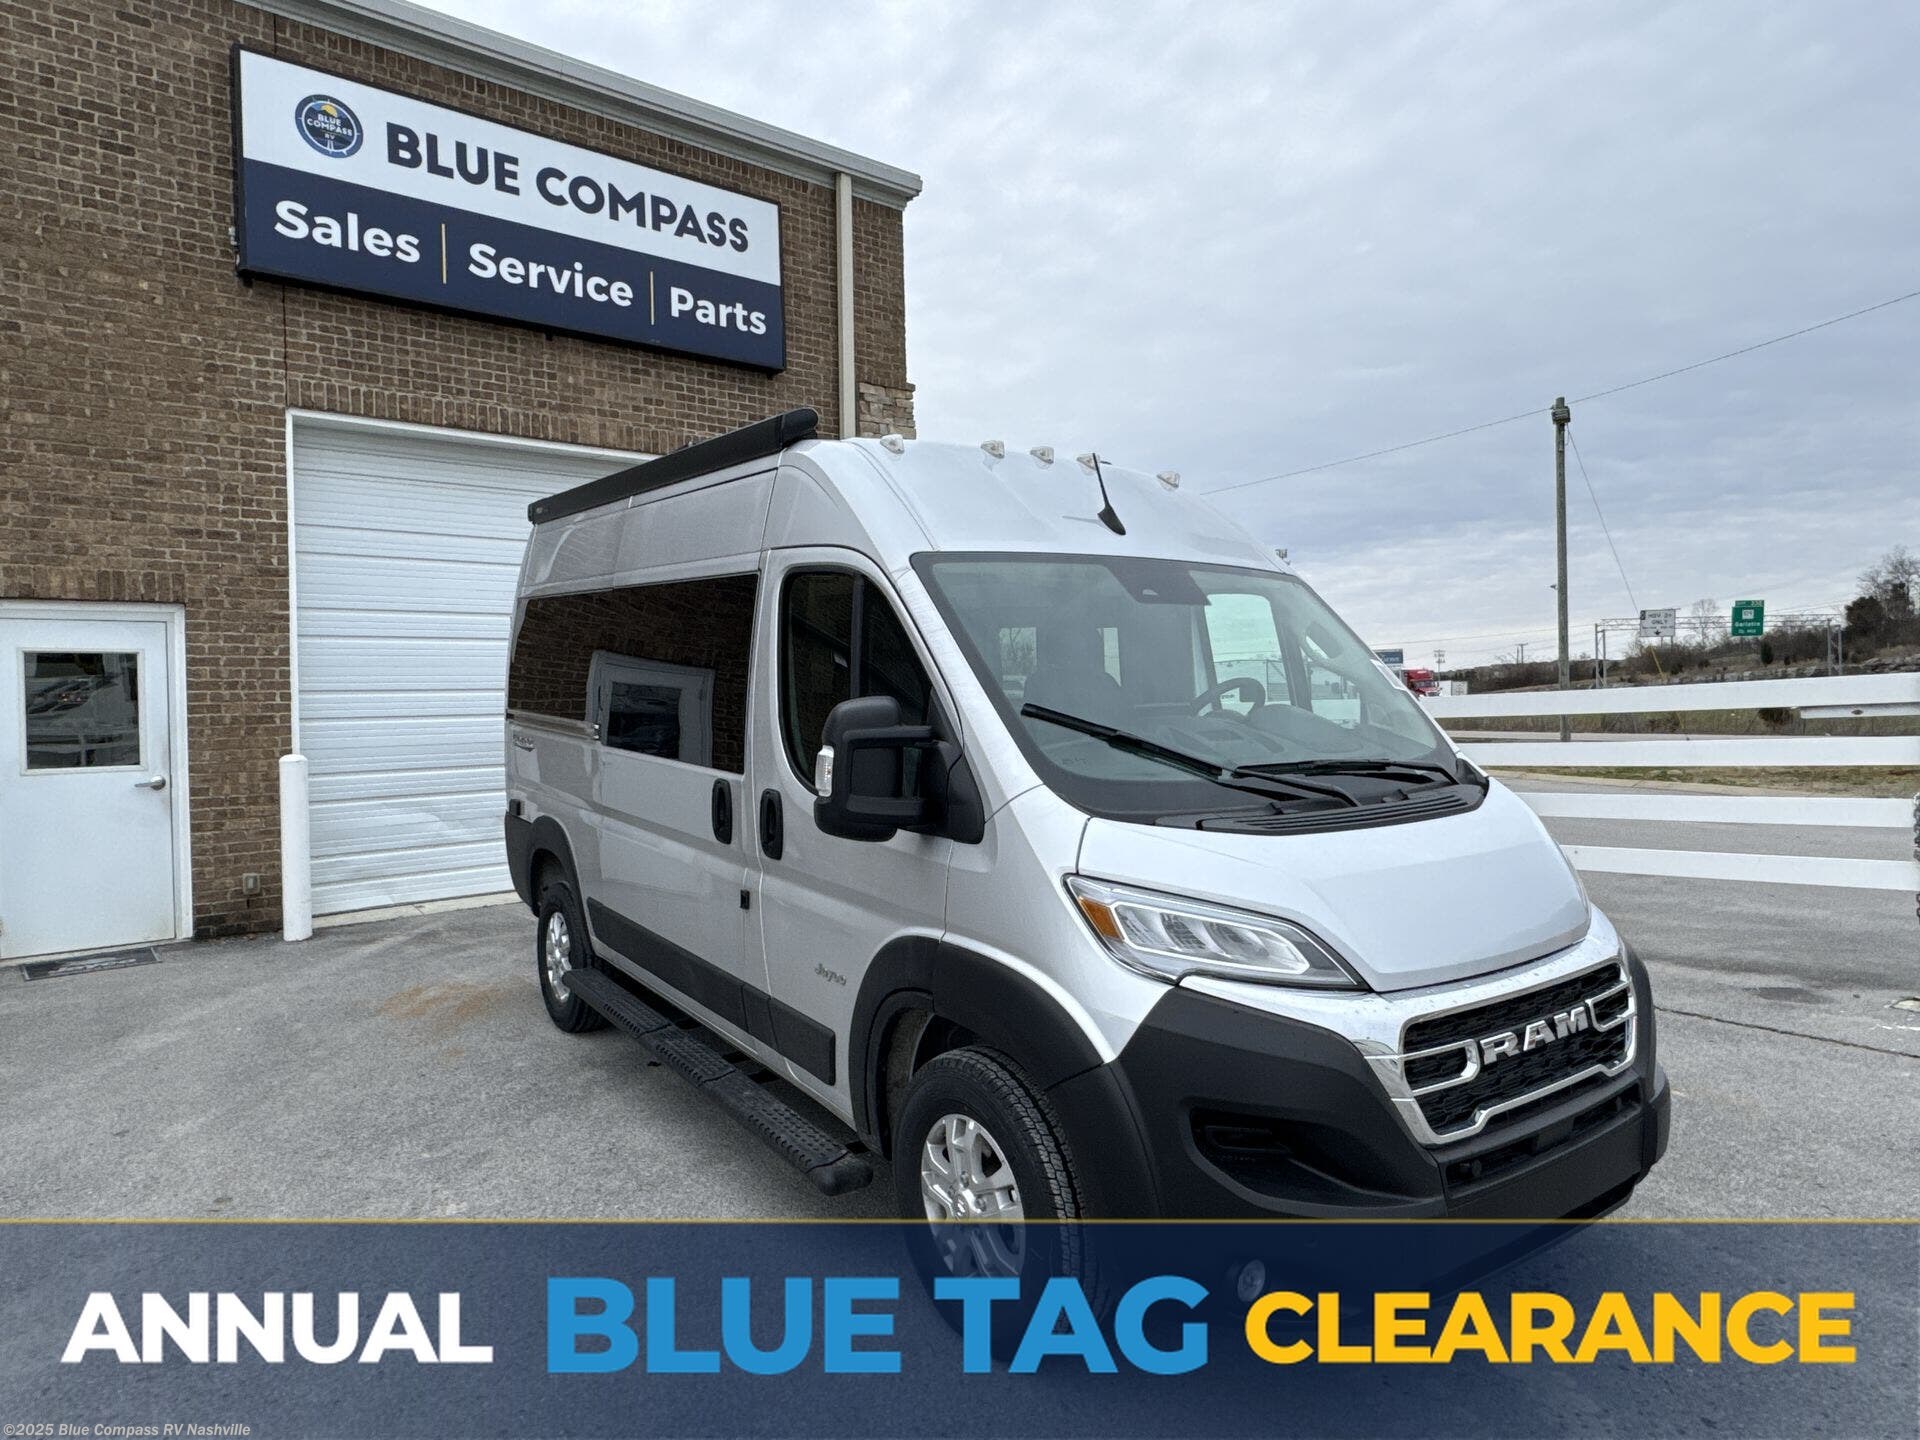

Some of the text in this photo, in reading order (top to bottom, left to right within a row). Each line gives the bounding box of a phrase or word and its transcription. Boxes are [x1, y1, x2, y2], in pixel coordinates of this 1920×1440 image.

[306, 118, 353, 137] COMPASS
[317, 113, 342, 127] BLUE
[386, 122, 749, 252] BLUE COMPASS
[274, 200, 767, 335] Sales Service Parts
[1480, 1006, 1589, 1065] RAM
